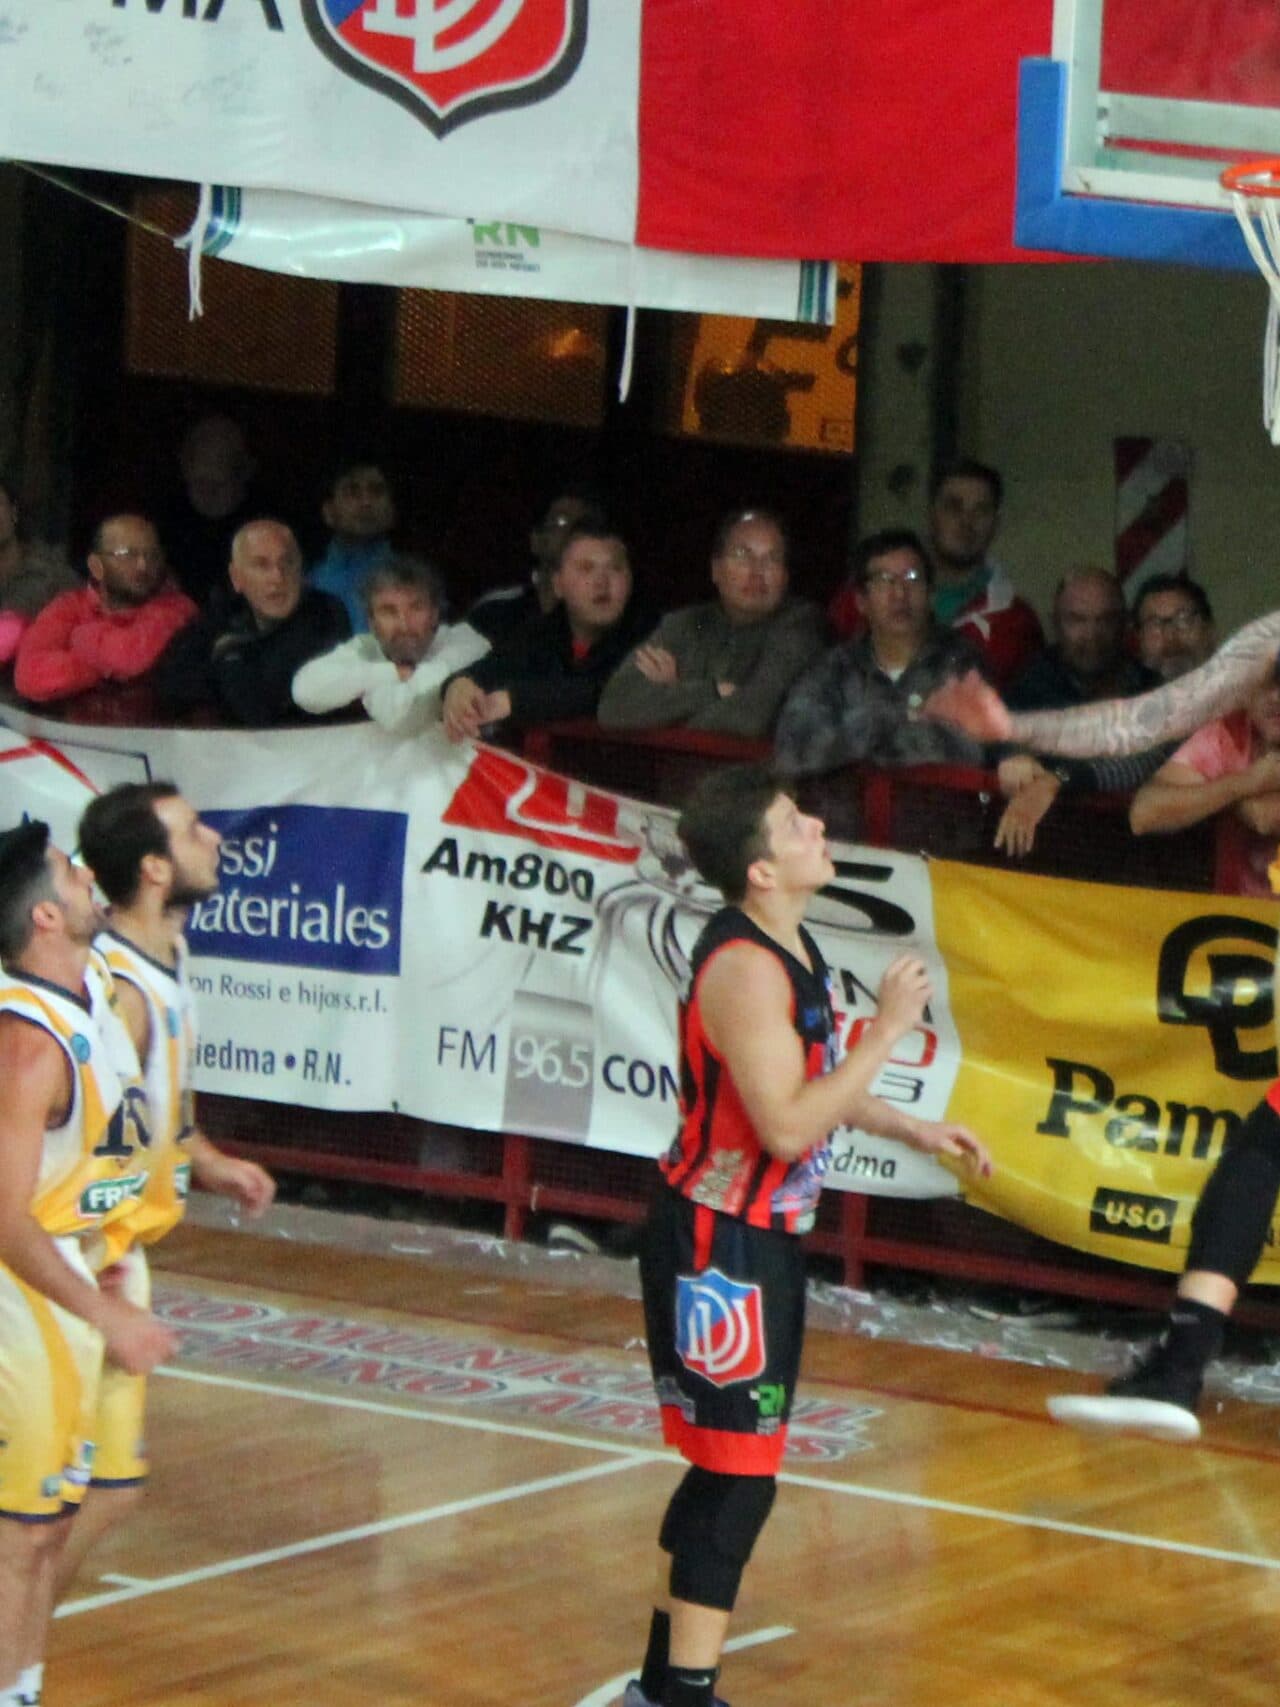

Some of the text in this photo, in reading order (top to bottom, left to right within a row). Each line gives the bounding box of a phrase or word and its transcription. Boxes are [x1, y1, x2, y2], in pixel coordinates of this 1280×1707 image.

[219, 822, 279, 878] ssi
[480, 900, 593, 956] KHZ
[221, 973, 272, 1000] Rossi
[279, 986, 291, 1002] e
[195, 1036, 352, 1086] iedma R.N.
[437, 1024, 497, 1074] FM
[1035, 1056, 1242, 1160] Pam
[1103, 1199, 1170, 1232] USO
